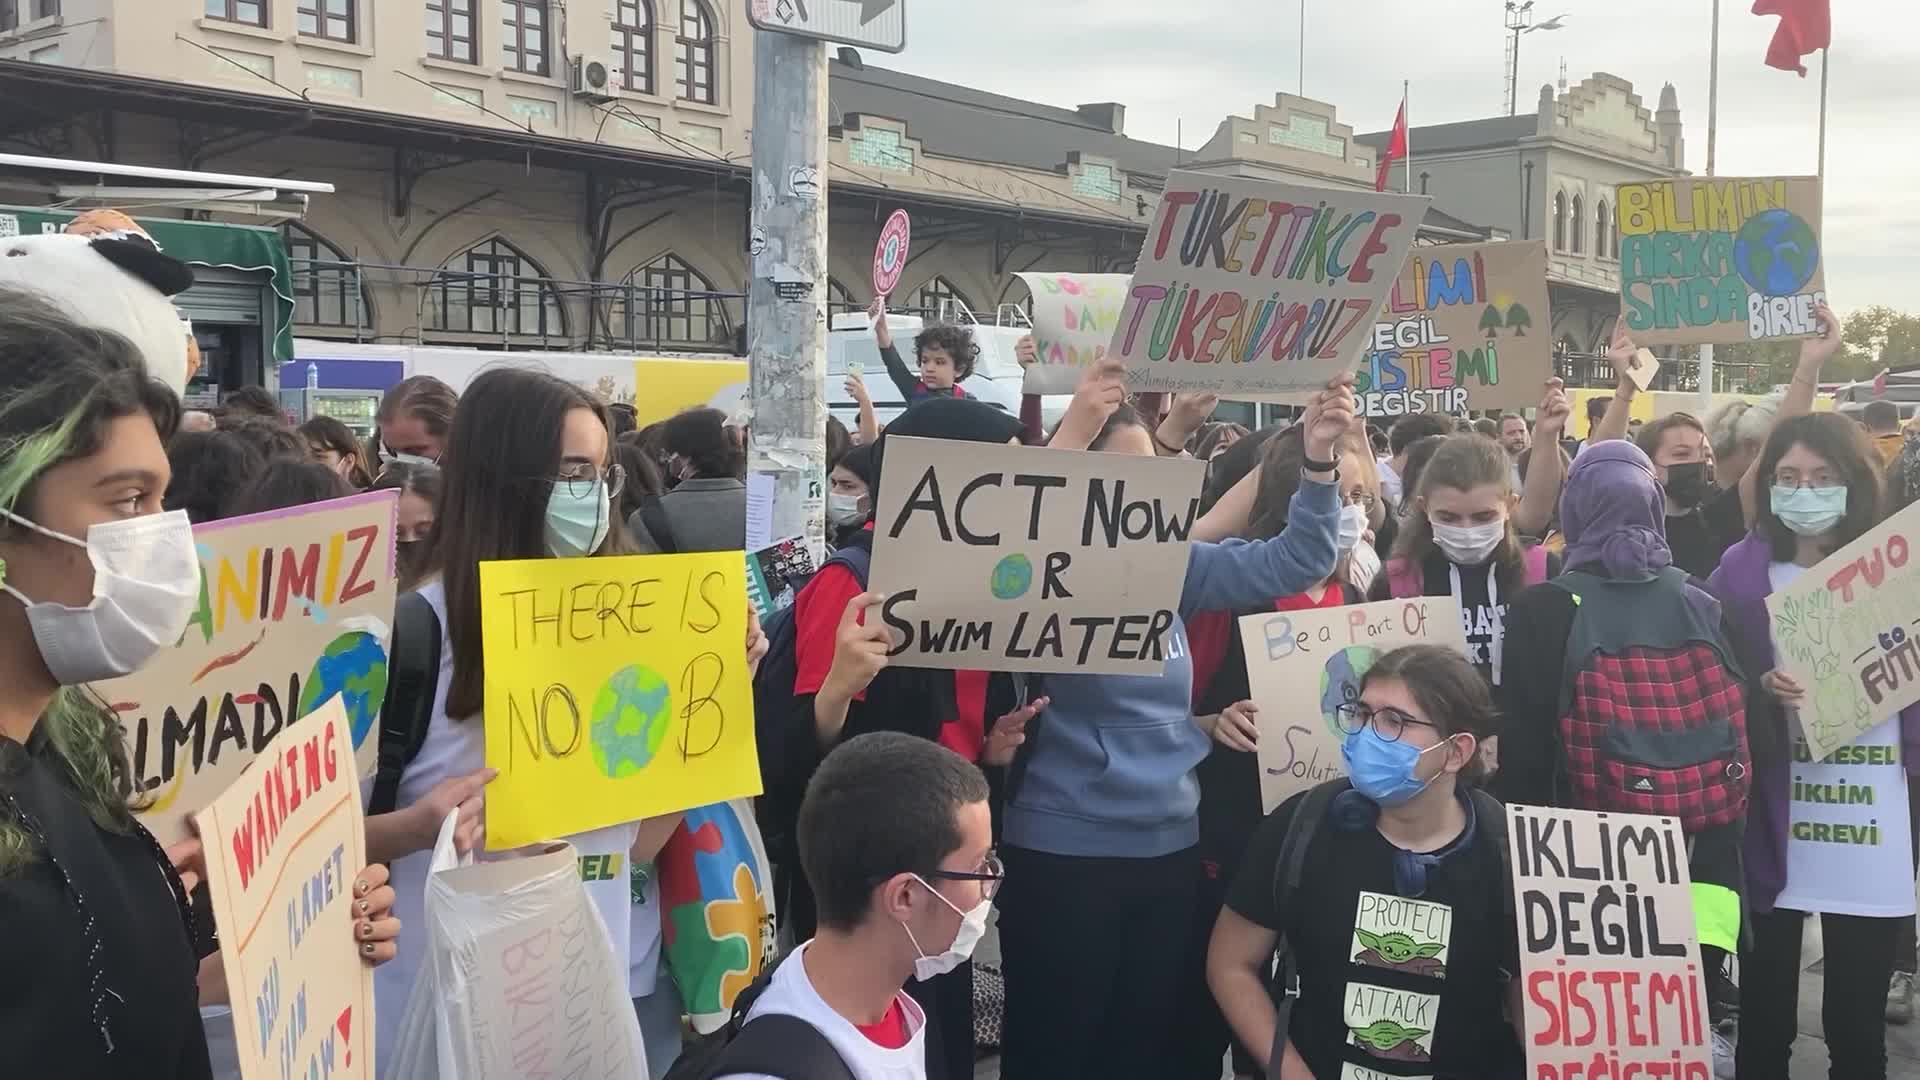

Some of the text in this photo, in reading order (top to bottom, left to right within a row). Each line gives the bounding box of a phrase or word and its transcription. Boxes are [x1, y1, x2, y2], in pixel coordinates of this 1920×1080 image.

[1154, 188, 1401, 287] TÜKETTİKÇE
[1621, 231, 1737, 280] ARKA
[1384, 250, 1487, 313] LİMİ
[1622, 273, 1748, 331] SINDA
[1366, 314, 1449, 351] EĞİL
[889, 465, 1067, 546] ACT
[1827, 535, 1908, 602] TWO
[500, 579, 662, 650] THERE
[680, 569, 725, 634] IS
[1004, 610, 1173, 665] LATER
[1263, 602, 1427, 662] Be a Part Of
[508, 652, 724, 777] NO B
[232, 720, 337, 892] WARNING
[1794, 775, 1874, 806] İKLİM
[1514, 806, 1679, 885] İKLİMİ
[1793, 818, 1878, 846] GREVİ
[577, 854, 615, 882] EL
[1358, 894, 1450, 944] PROTECT
[1523, 883, 1687, 958] DEĞİL
[1351, 987, 1431, 1027] ATTACK
[1528, 958, 1704, 1047] SİSTEMİ
